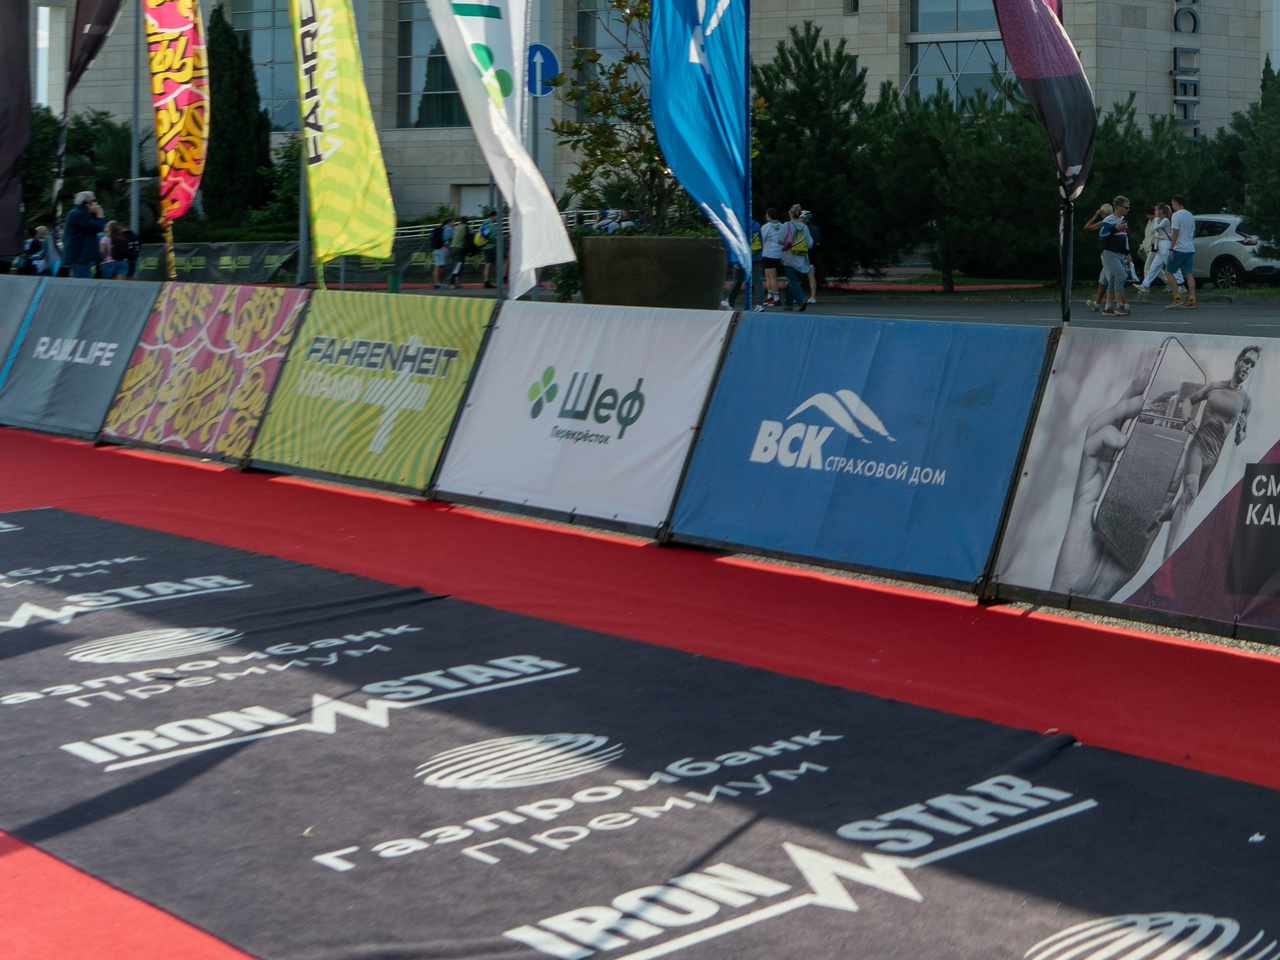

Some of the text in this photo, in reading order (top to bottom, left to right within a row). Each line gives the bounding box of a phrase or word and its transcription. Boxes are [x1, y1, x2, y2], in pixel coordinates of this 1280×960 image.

[304, 336, 461, 378] FAHRENHEIT
[557, 371, 645, 440] Шеф
[749, 419, 835, 471] ВСК
[824, 455, 947, 486] СТРАХОВОЙ ДОМ
[64, 574, 245, 607] STAR
[312, 729, 846, 872] Газпромбанк
[461, 761, 830, 865] Премиум
